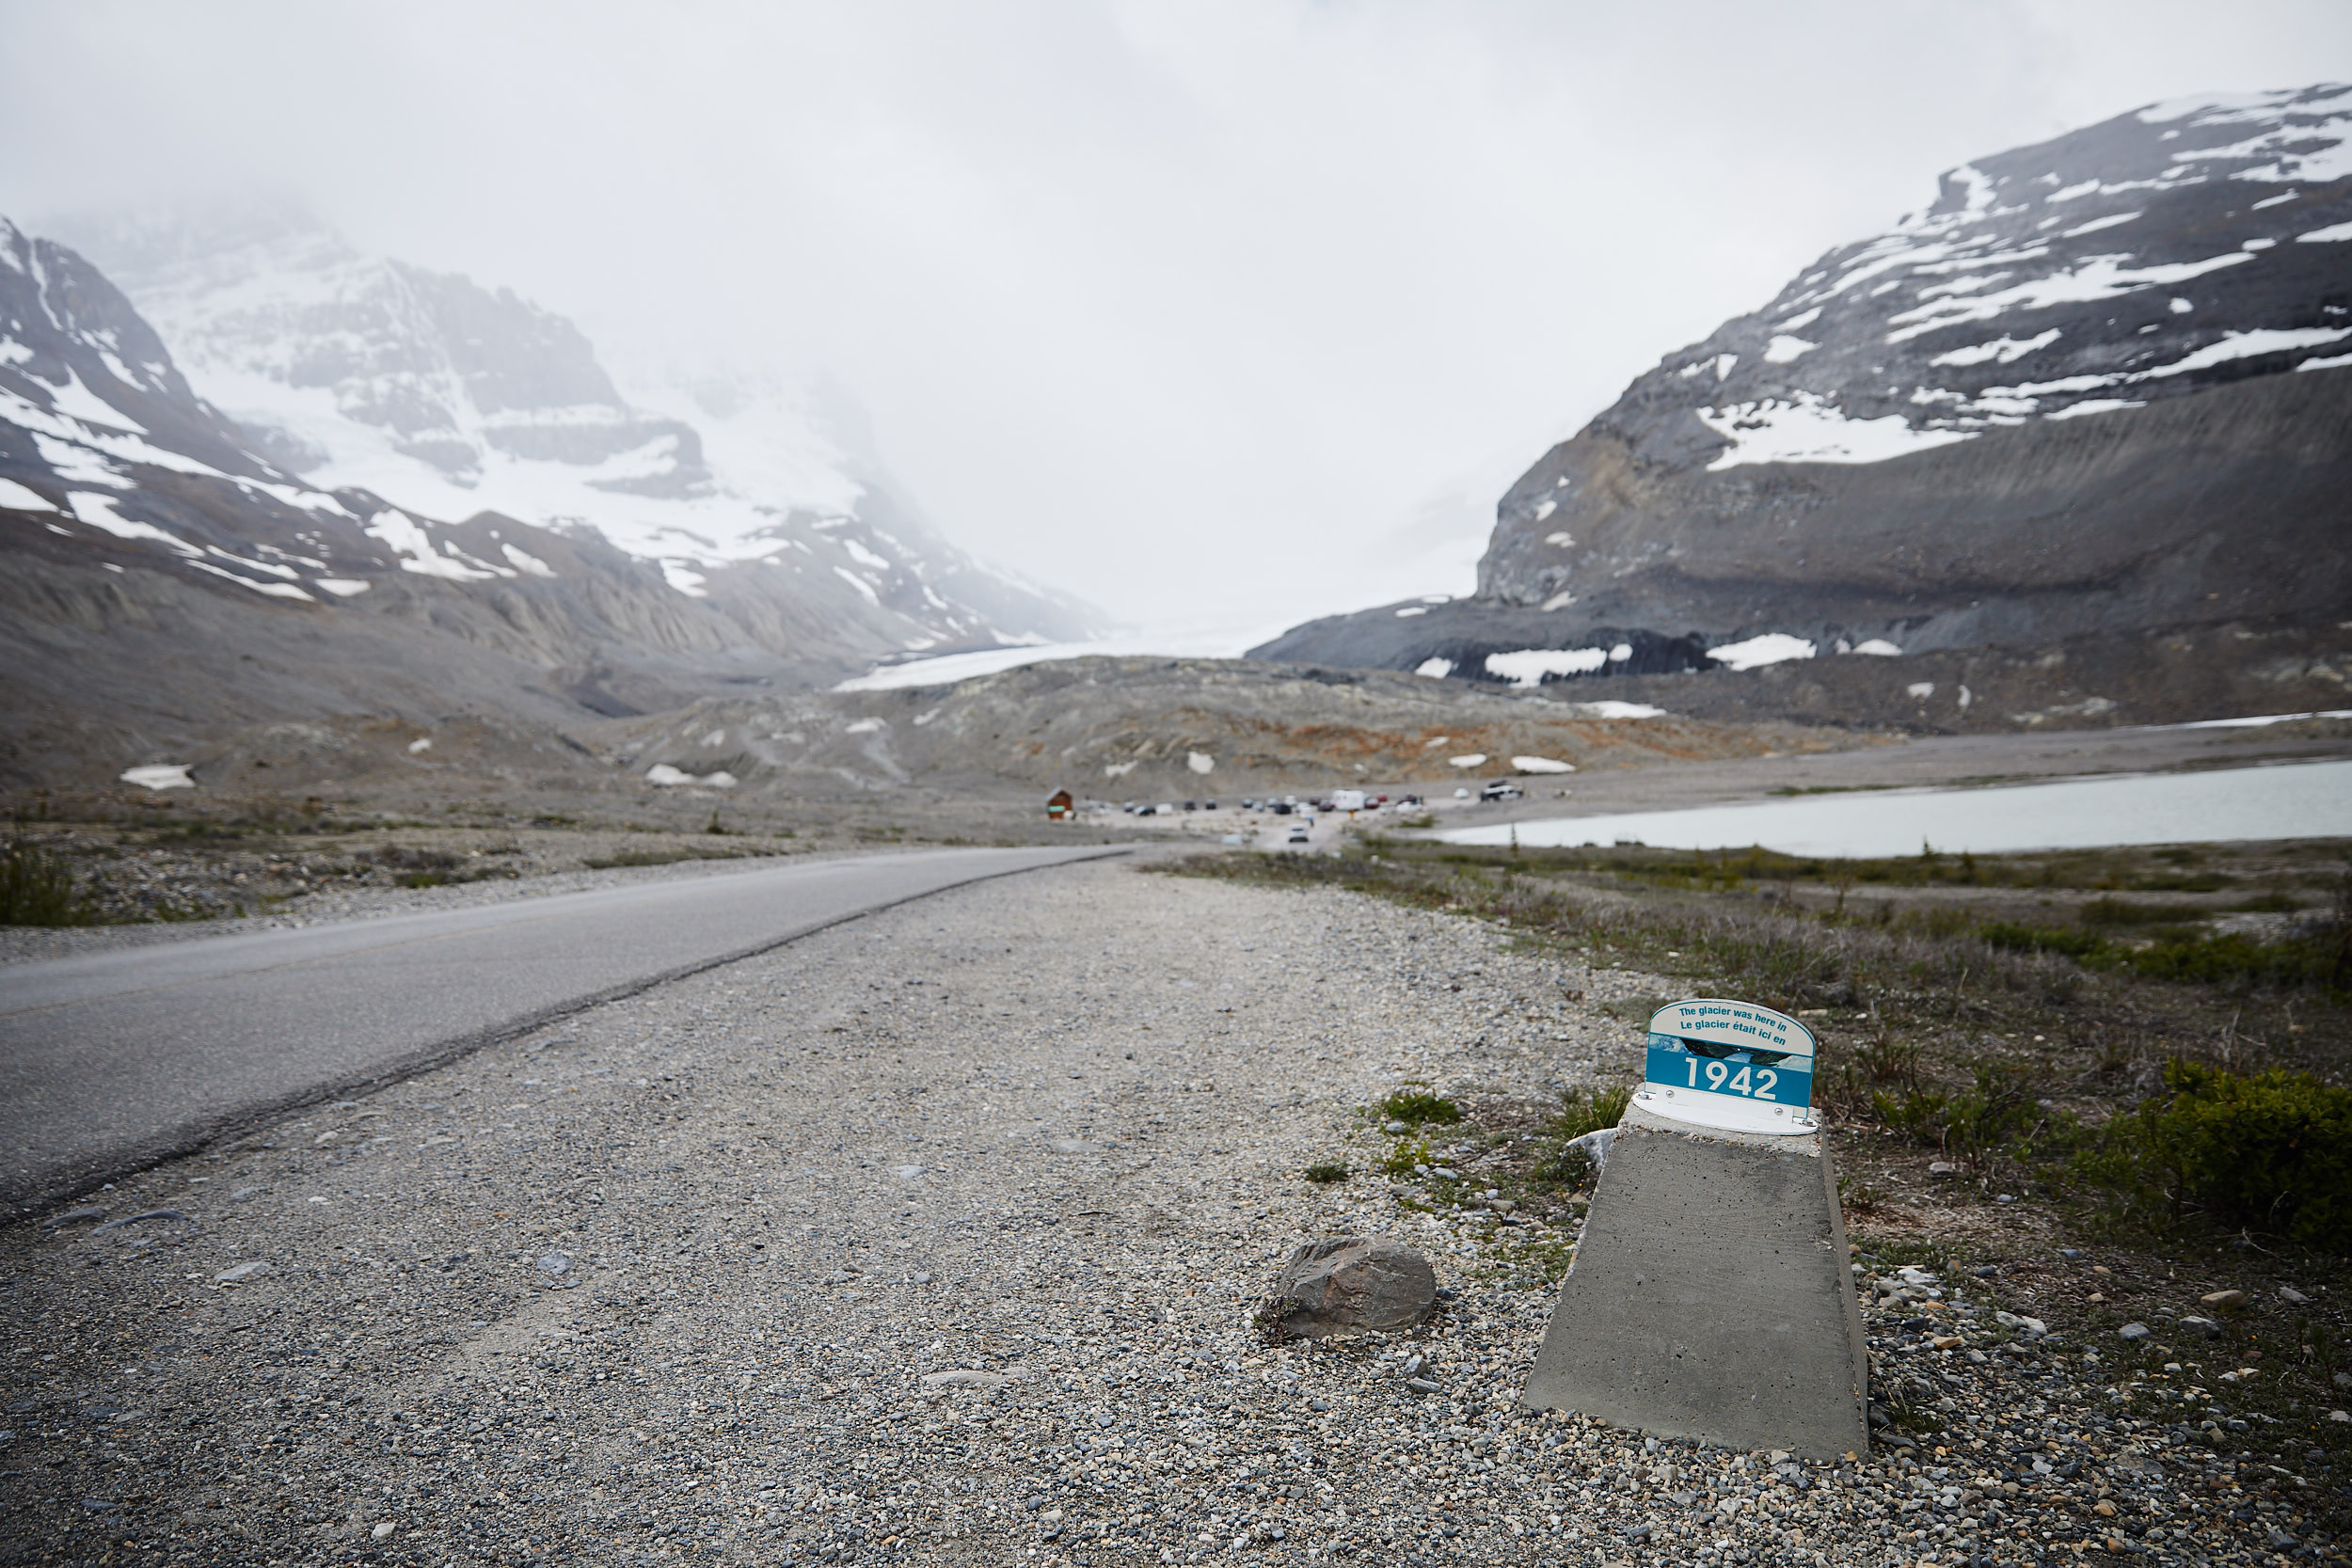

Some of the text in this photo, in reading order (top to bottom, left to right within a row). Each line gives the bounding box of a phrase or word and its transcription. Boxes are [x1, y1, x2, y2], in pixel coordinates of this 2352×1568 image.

[1679, 1006, 1787, 1032] The glacier was here in
[1680, 1021, 1786, 1045] Le glacier était ici en
[1685, 1057, 1778, 1101] 1942
